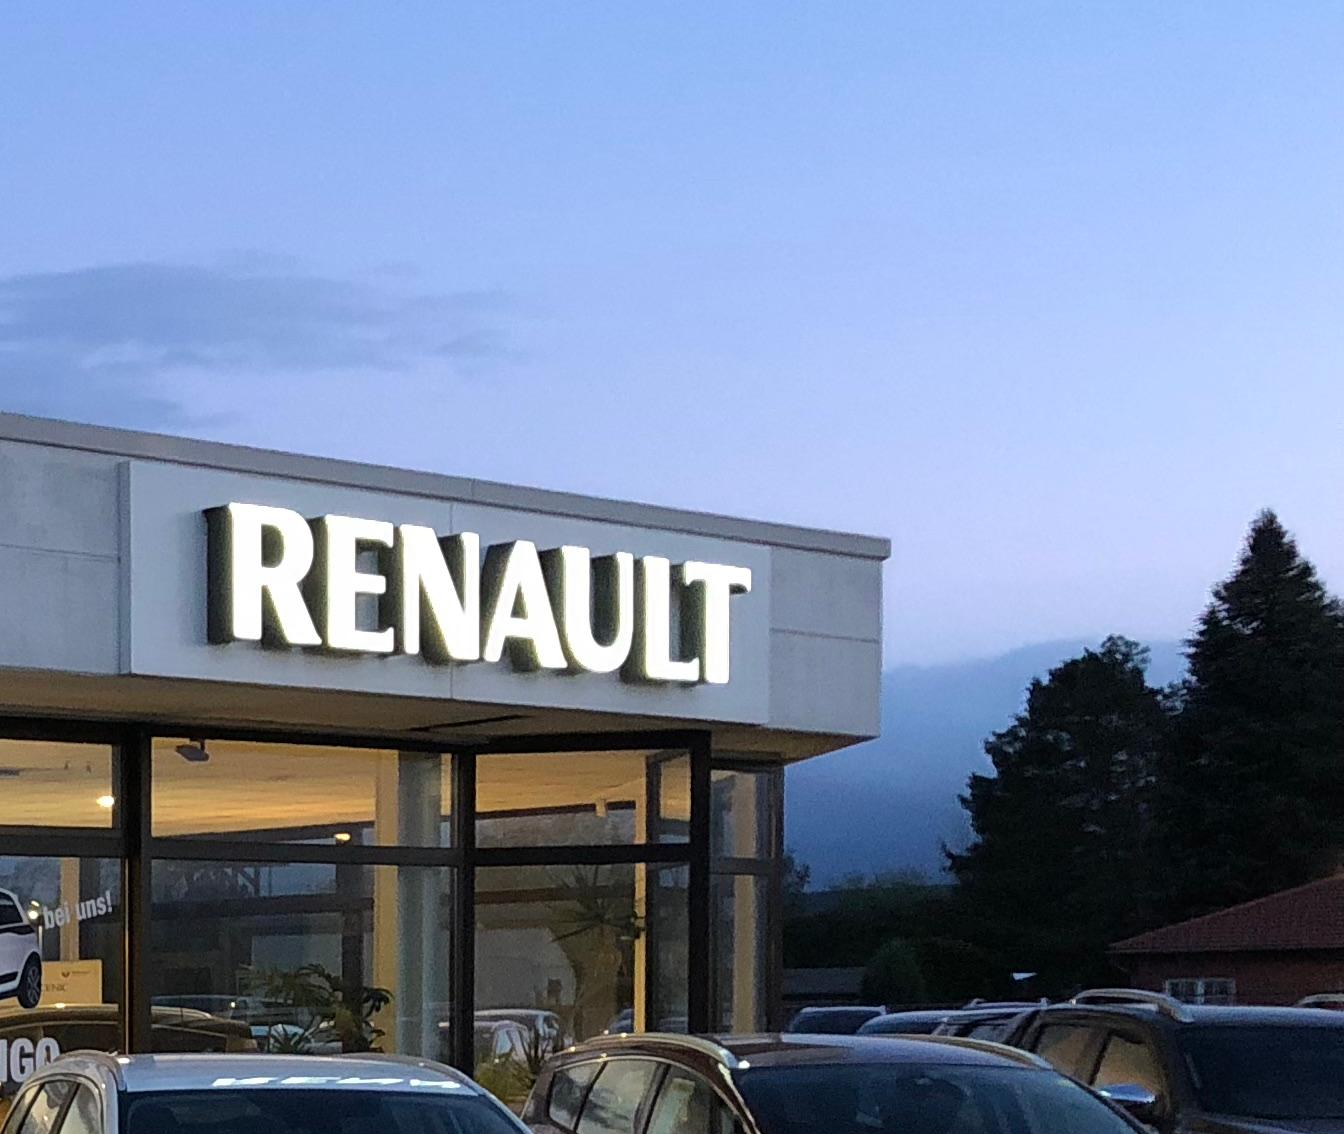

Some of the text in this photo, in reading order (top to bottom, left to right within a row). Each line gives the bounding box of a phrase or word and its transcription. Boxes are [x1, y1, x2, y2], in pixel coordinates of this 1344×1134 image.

[220, 500, 752, 685] RENAULT
[42, 889, 113, 930] bei uns!
